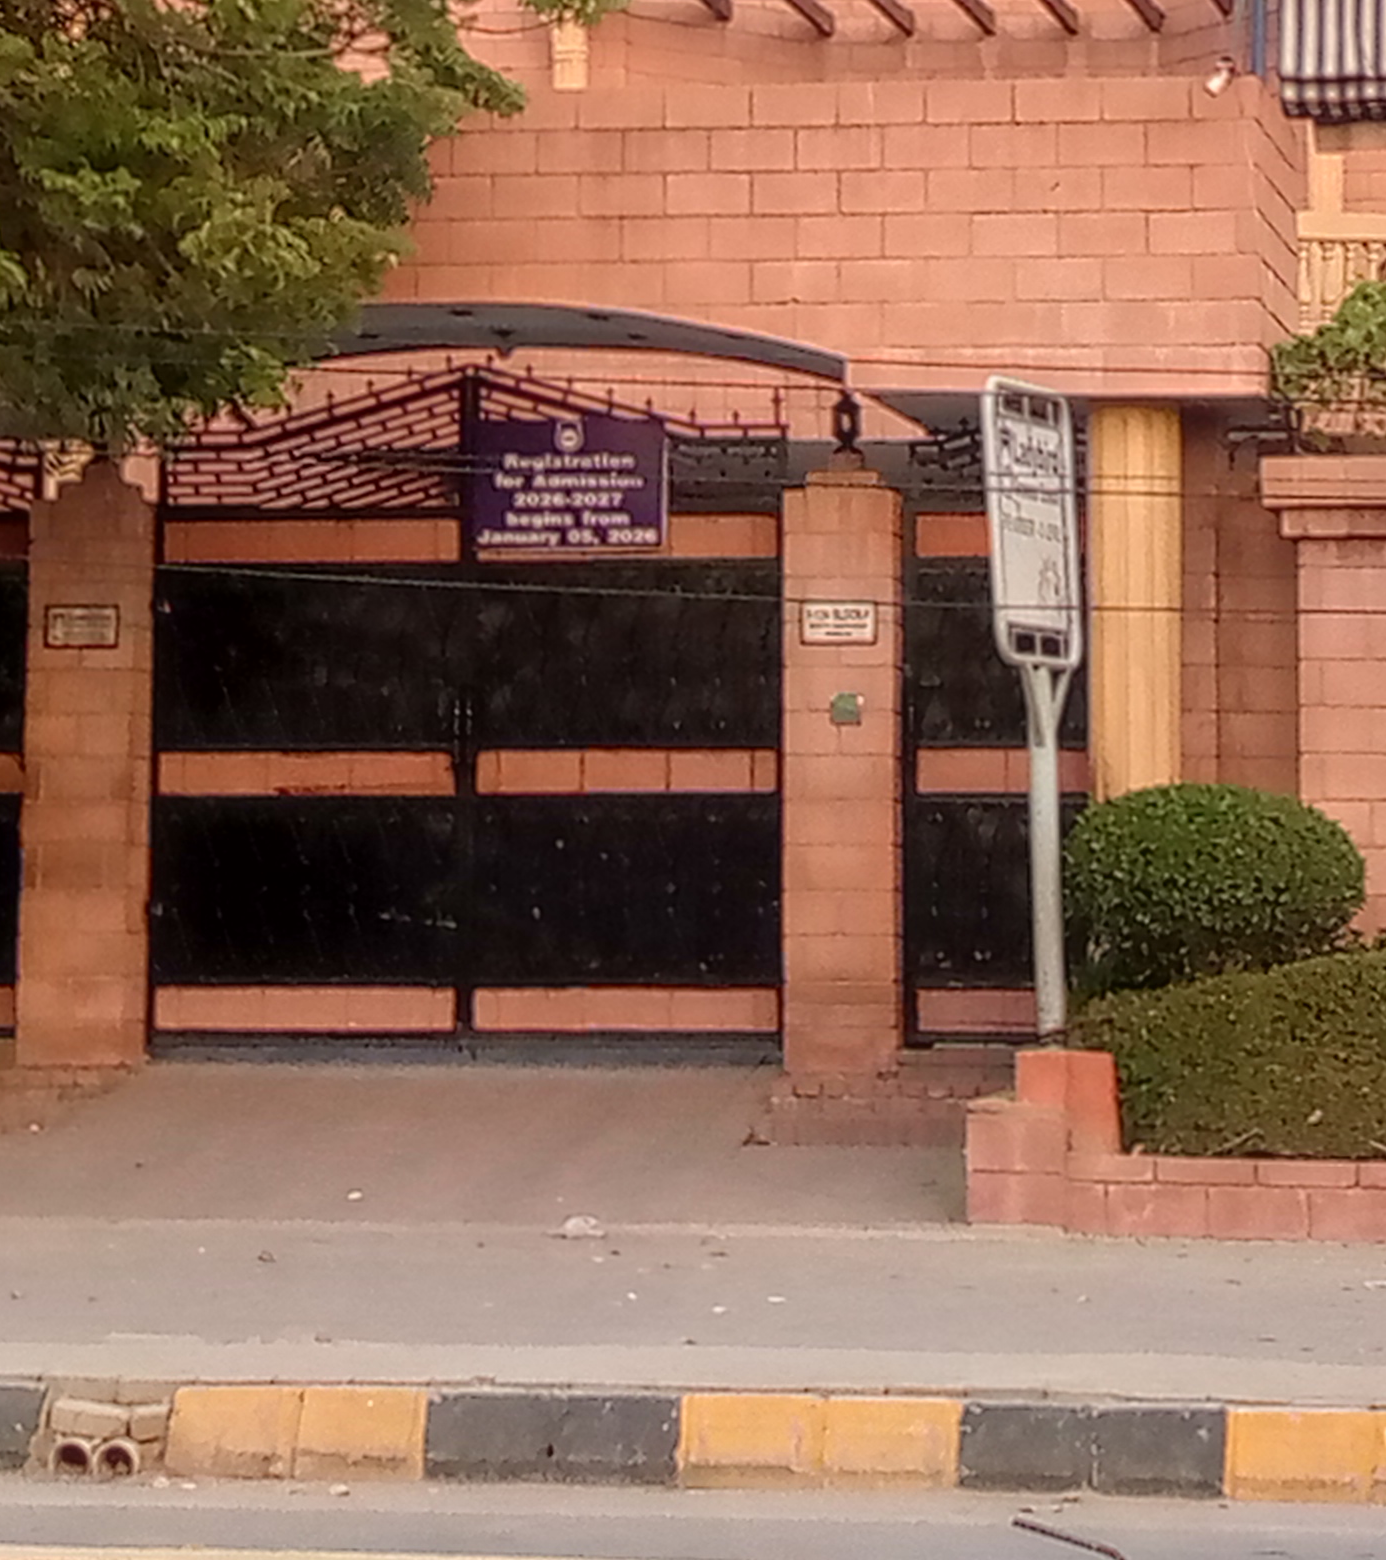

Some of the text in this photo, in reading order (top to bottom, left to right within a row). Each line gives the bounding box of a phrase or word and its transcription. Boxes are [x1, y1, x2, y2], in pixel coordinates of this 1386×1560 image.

[503, 453, 635, 470] Registration
[495, 473, 525, 488] for
[514, 493, 623, 507] 2026-2027
[506, 511, 631, 528] begins from
[477, 529, 561, 546] January
[608, 529, 658, 544] 2026
